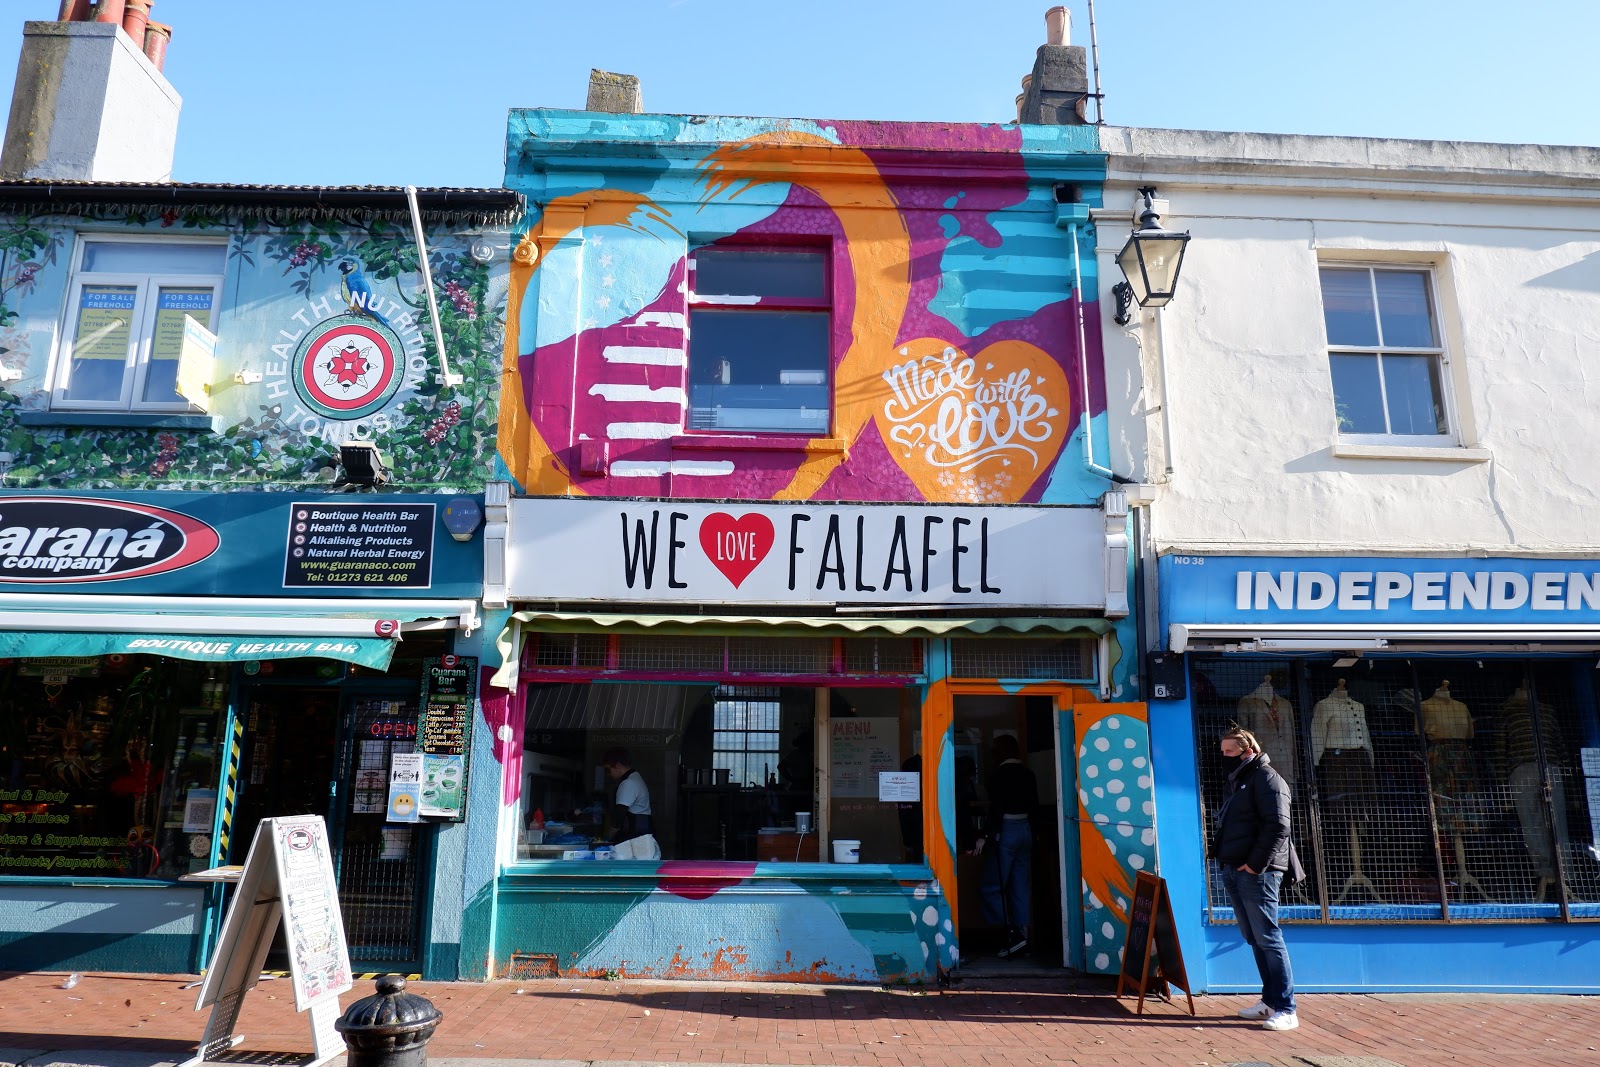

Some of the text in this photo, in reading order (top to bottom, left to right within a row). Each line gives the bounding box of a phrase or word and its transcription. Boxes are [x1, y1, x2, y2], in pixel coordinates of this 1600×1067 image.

[88, 301, 132, 309] FREEHOLD
[350, 291, 427, 390] NUTRITION
[265, 296, 332, 400] HEALTH
[975, 367, 1032, 404] with
[286, 404, 391, 442] TONICS
[311, 510, 419, 522] Boutique Health Bar
[310, 523, 406, 533] Health & Nutrition
[309, 536, 413, 547] Alkalising Products
[308, 548, 425, 560] Natural Herbal Energy
[621, 510, 1002, 594] WE LOVE FALAFEL
[2, 554, 120, 573] company
[300, 561, 416, 571] www.guaranaco.com
[1174, 556, 1205, 565] NO 38
[306, 573, 408, 582] Tel: 01273 621 406
[1236, 570, 1600, 611] INDEPEN
[127, 639, 360, 655] BOUTIQUE HEALTH BAR
[431, 667, 466, 678] Guarana
[438, 676, 455, 685] Bar
[1157, 687, 1164, 696] 6
[371, 723, 416, 736] OPEN
[833, 721, 871, 736] MENU
[21, 789, 33, 801] &
[35, 789, 69, 803] Body
[15, 811, 27, 823] &
[28, 811, 70, 824] Juices
[31, 832, 42, 845] &
[45, 833, 128, 848] Supplements
